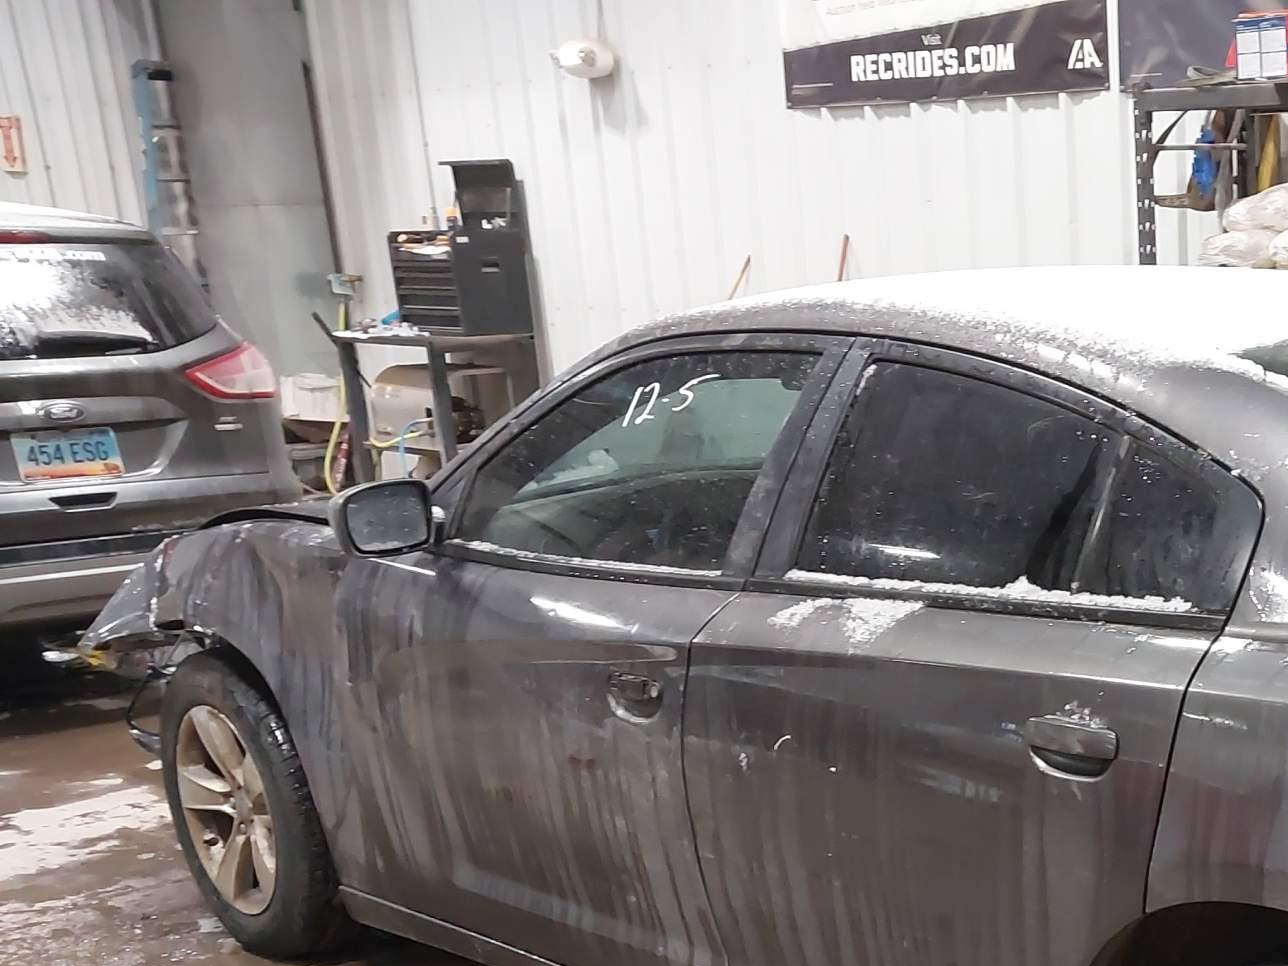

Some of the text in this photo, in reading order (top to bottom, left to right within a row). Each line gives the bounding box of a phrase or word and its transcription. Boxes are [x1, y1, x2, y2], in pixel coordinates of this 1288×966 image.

[850, 43, 1016, 82] RECRIDES.COM
[621, 373, 721, 427] 12-5
[27, 440, 110, 467] 454 ESG
